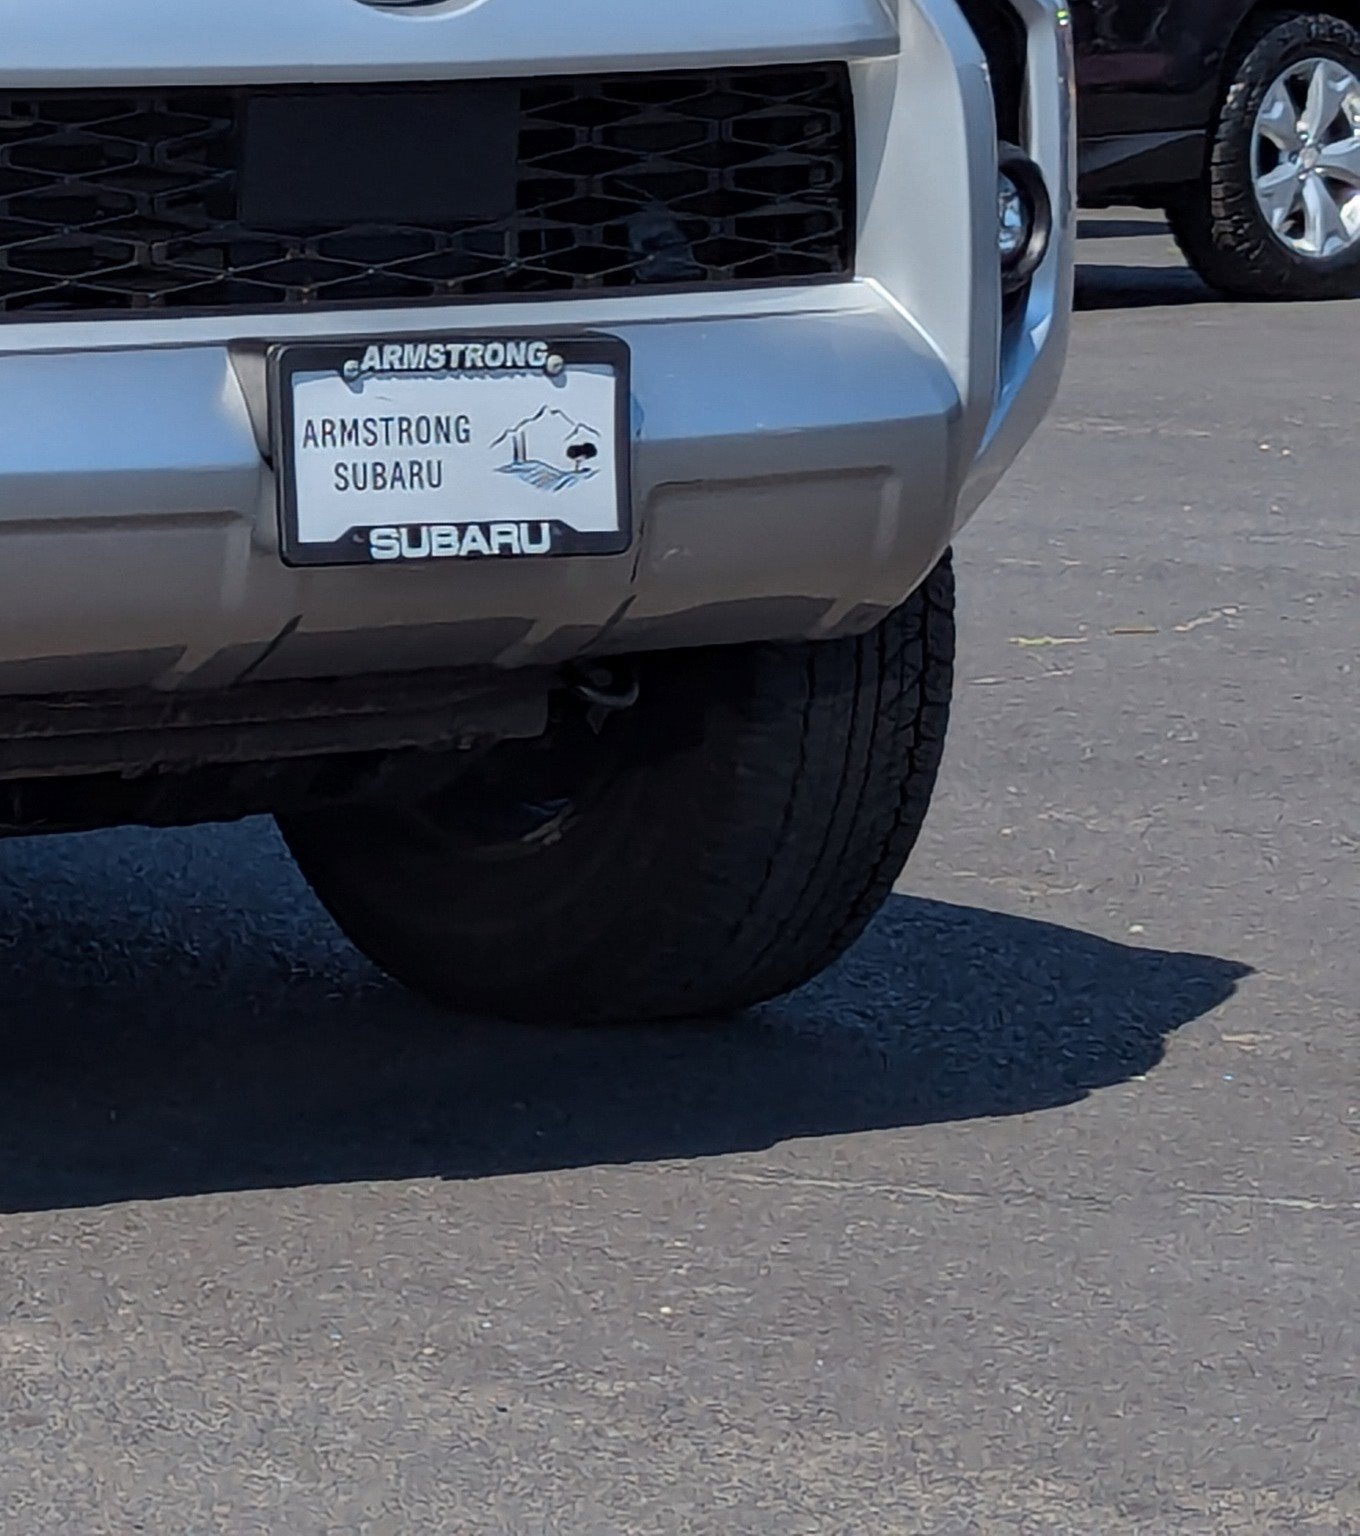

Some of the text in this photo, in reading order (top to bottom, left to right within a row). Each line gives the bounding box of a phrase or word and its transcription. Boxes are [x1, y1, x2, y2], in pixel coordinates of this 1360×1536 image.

[360, 341, 549, 371] ARMSTRONG
[302, 415, 471, 450] ARMSTRONG
[333, 460, 443, 492] SUBARU
[369, 522, 552, 560] SUBARU
